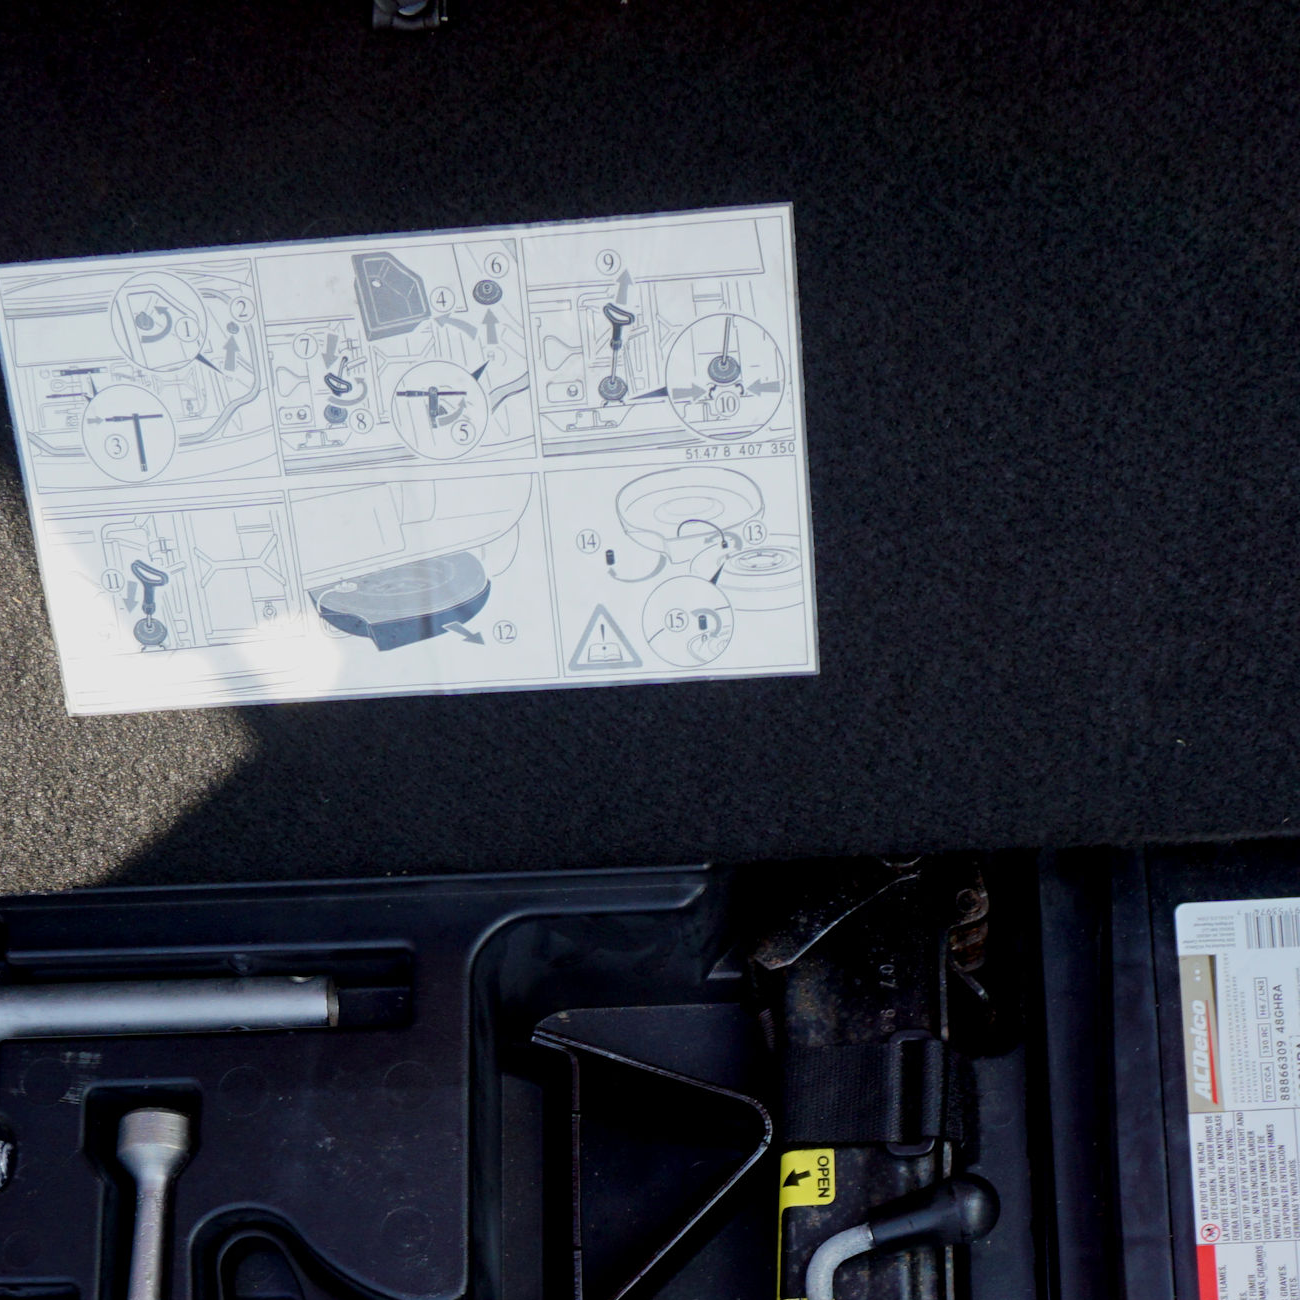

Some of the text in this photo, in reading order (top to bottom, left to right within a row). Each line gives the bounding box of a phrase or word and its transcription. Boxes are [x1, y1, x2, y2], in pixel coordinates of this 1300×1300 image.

[491, 256, 502, 274] 6
[603, 253, 614, 271] 9
[436, 291, 447, 308] 4
[237, 301, 248, 318] 2
[184, 322, 191, 338] 1
[300, 338, 311, 356] 7
[720, 396, 736, 413] 10
[356, 413, 367, 430] 8
[460, 424, 469, 441] 5
[112, 437, 122, 455] 3
[685, 439, 796, 460] 51.47 8 407 350
[579, 533, 597, 550] 14
[747, 524, 763, 541] 13
[107, 573, 120, 589] 11
[668, 612, 685, 629] 15
[497, 624, 513, 641] 12
[1257, 980, 1267, 1016] H6 LN3
[1261, 1026, 1268, 1038] RC
[1188, 999, 1212, 1102] ACDelco
[1272, 984, 1291, 1102] 88866309 48GHRA
[1264, 1066, 1273, 1099] 770 CCA
[1236, 1111, 1244, 1127] AND
[1237, 1127, 1246, 1147] TIGHT
[1238, 1147, 1247, 1166] CAPS
[1266, 1123, 1280, 1208] NO CONSERVE FIRMES
[1204, 1114, 1219, 1220] OF GARDER HORS DE
[1239, 1166, 1248, 1184] VENT
[1247, 1129, 1260, 1215] NE PAS GARDER
[817, 1155, 831, 1198] OPEN
[1196, 1141, 1209, 1221] KEEP OUT OF THE REACH
[1227, 1151, 1240, 1241] FUERA DEL ALCANCE DE LOS
[1240, 1184, 1249, 1202] KEEP
[1257, 1134, 1272, 1240] COUVERCLES BIEN ET DE
[1219, 1197, 1230, 1242] LA ES
[1280, 1185, 1292, 1239] LOS TAPONES DE
[1242, 1215, 1251, 1230] NOT
[1243, 1230, 1252, 1241] DO
[1255, 1245, 1265, 1278] CIGARROS
[1248, 1274, 1257, 1297] FUMER
